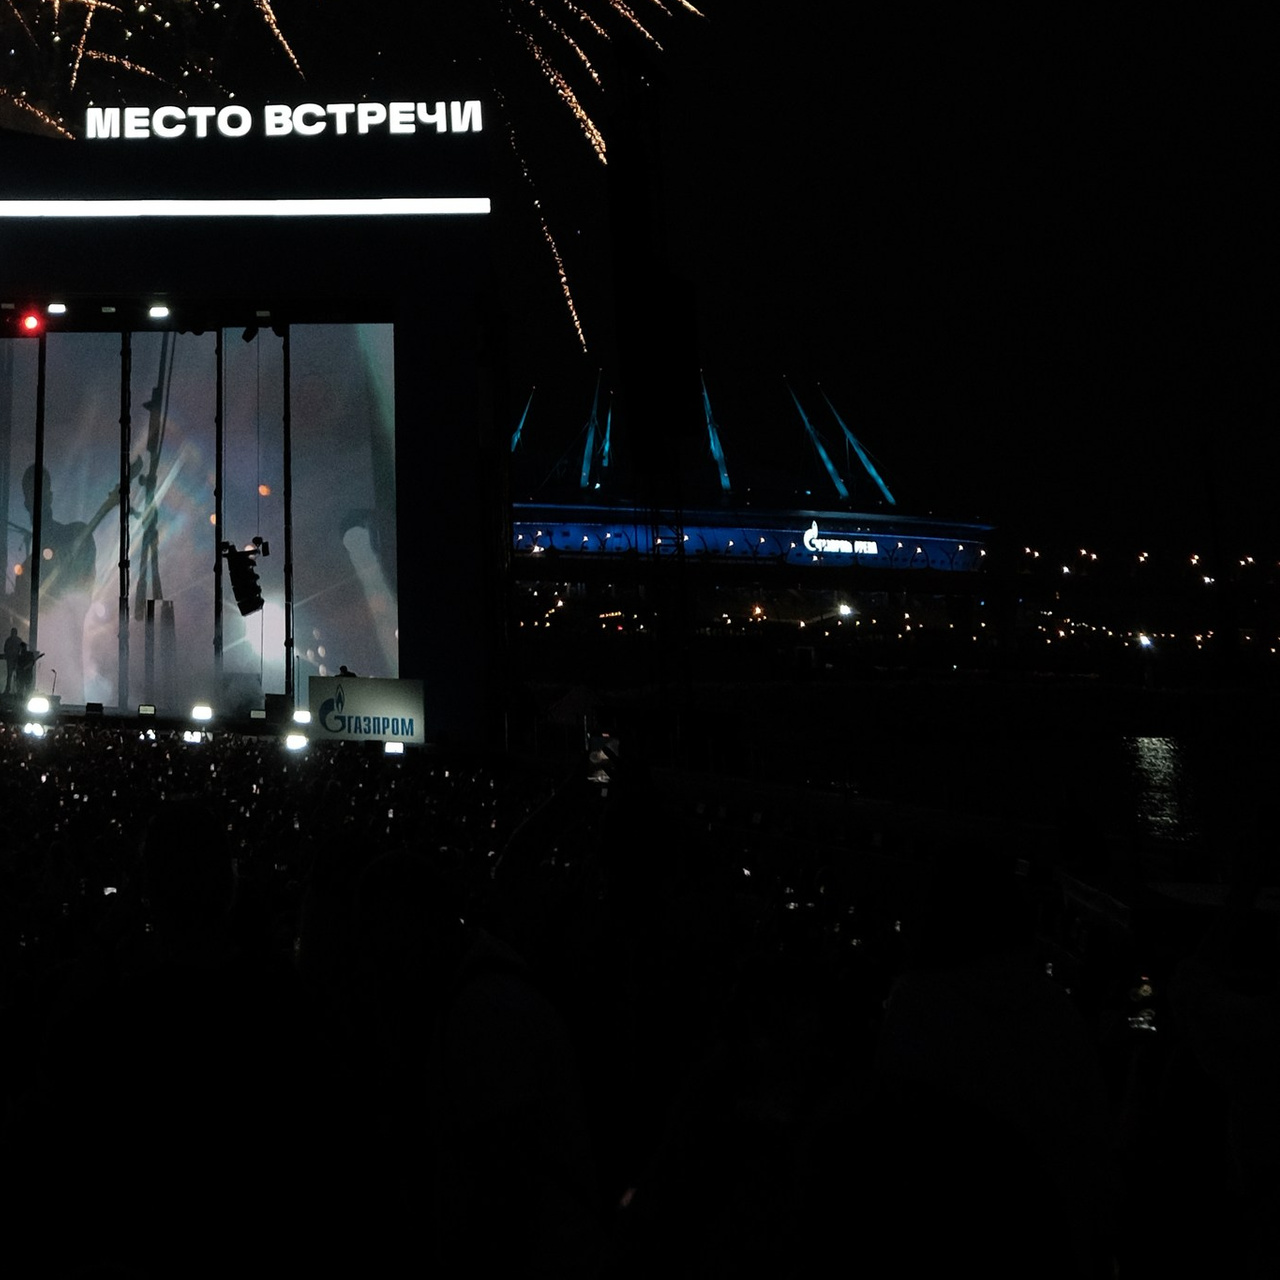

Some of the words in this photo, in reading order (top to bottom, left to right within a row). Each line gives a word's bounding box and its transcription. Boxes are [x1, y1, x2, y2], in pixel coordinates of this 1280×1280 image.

[86, 105, 253, 139] МЕСТО
[264, 100, 483, 137] ВСТРЕЧИ
[346, 715, 415, 737] ГАЗПРОМ
